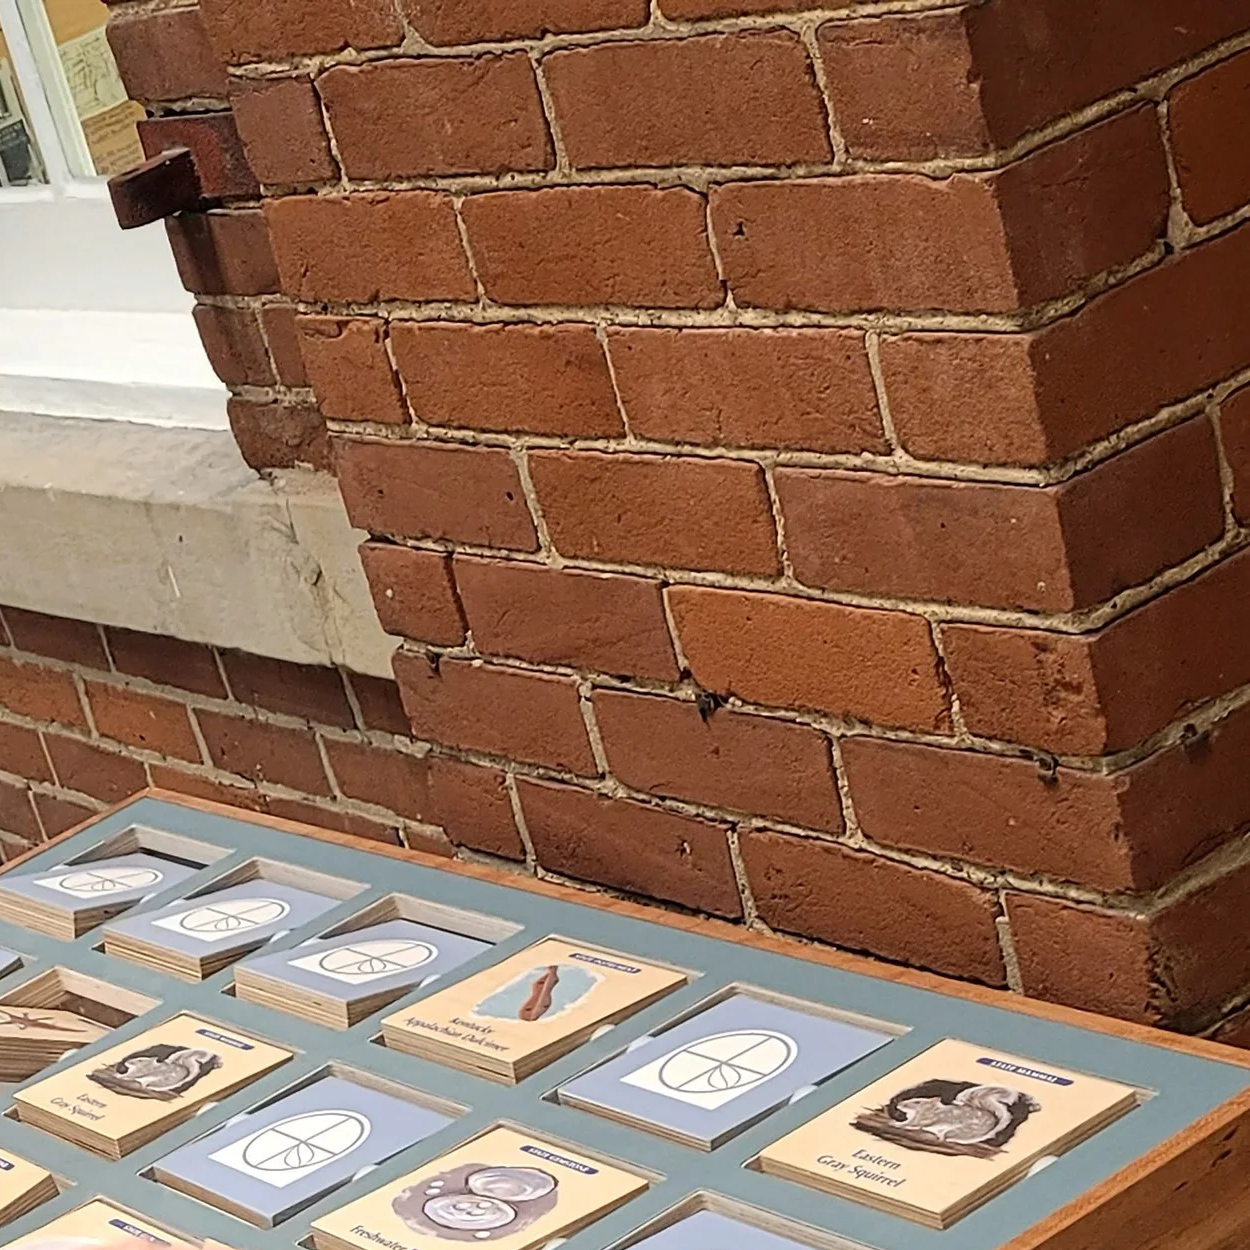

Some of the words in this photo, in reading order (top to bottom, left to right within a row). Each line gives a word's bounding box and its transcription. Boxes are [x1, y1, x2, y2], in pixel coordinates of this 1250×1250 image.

[816, 1154, 849, 1173] Gray
[849, 1163, 907, 1188] Squirrel
[851, 1149, 902, 1171] Eastern
